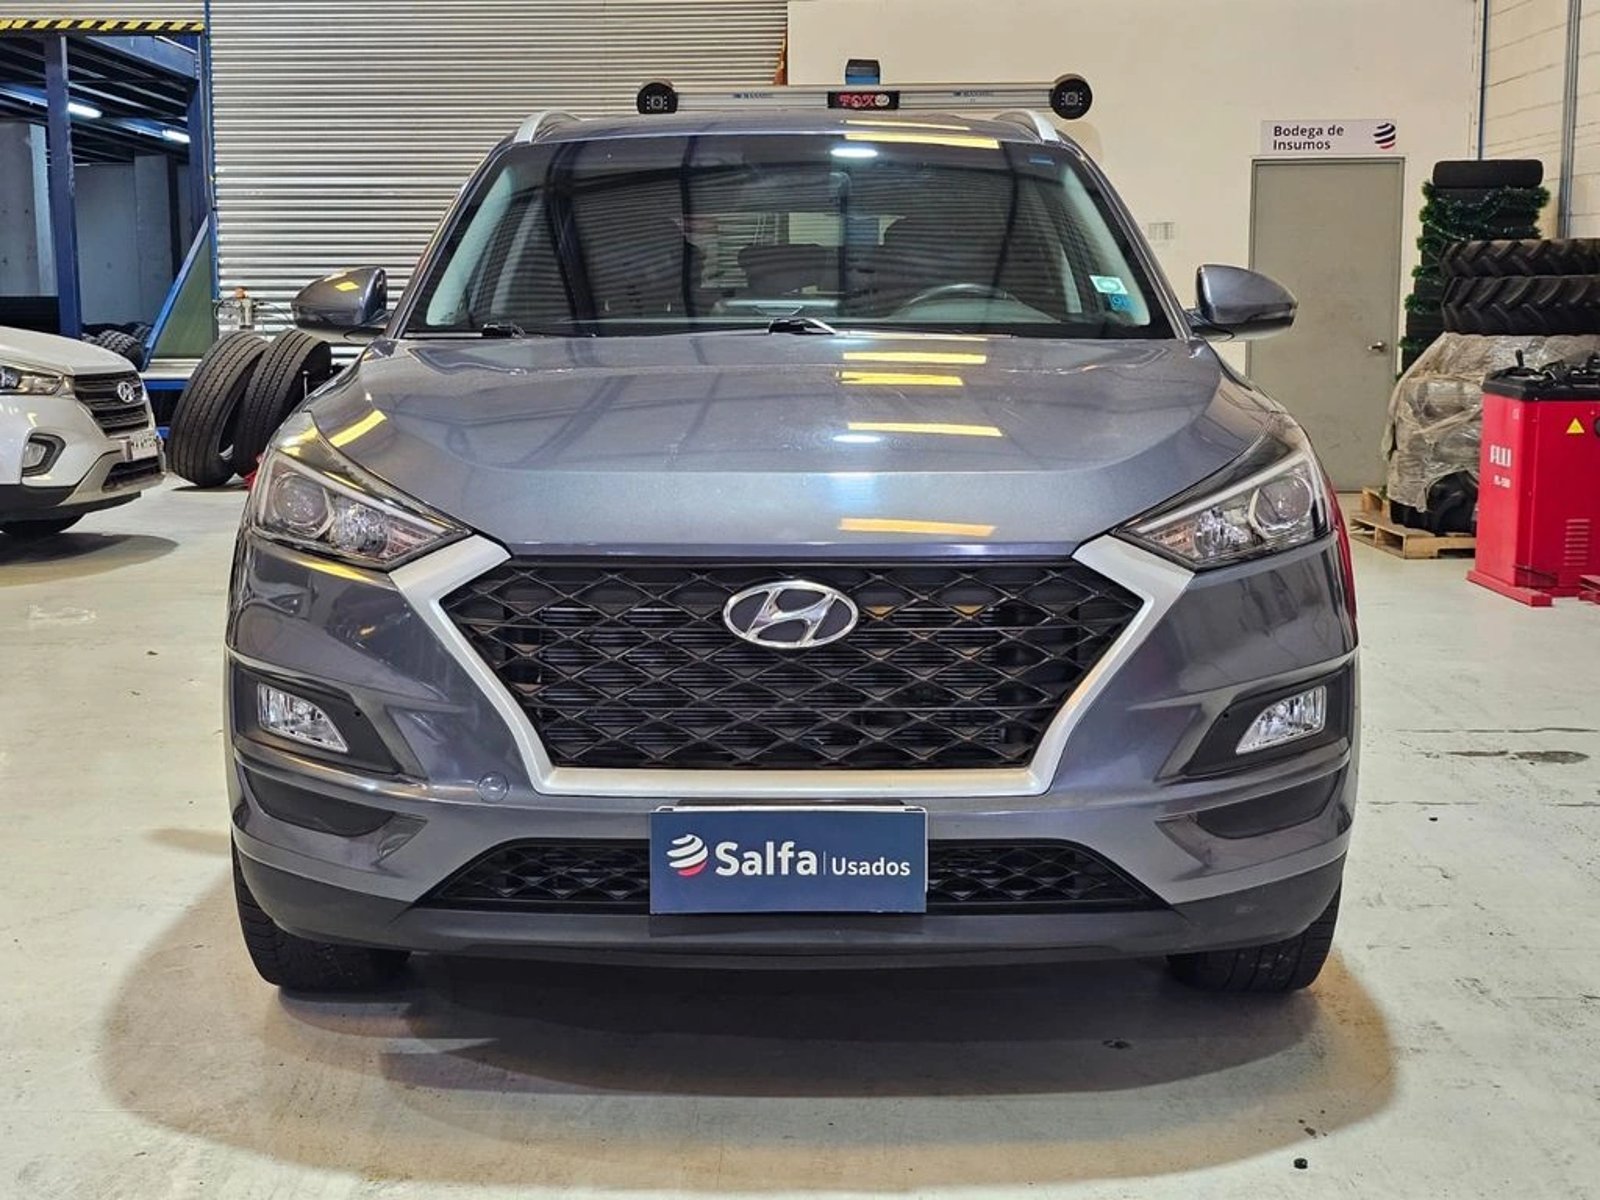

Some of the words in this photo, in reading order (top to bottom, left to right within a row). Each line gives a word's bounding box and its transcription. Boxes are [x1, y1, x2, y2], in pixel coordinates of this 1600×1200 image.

[1273, 125, 1323, 139] Bodega
[1327, 124, 1344, 136] de
[1273, 139, 1331, 151] Insumos
[715, 841, 817, 877] Salfa
[831, 856, 911, 876] Usados
